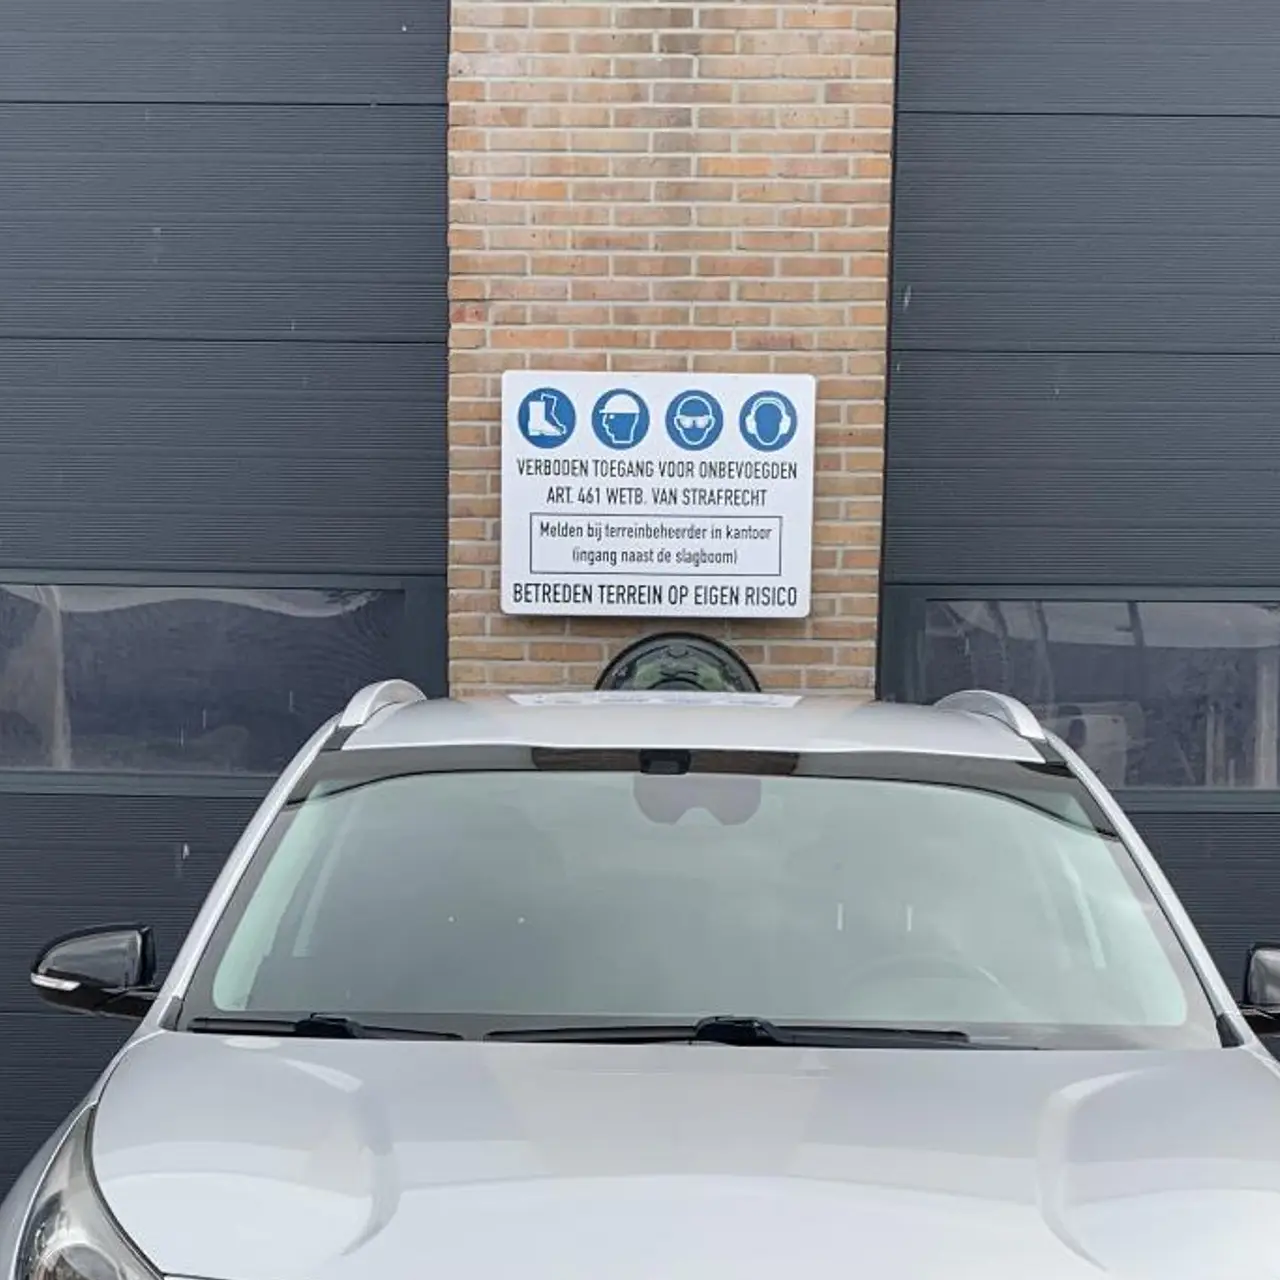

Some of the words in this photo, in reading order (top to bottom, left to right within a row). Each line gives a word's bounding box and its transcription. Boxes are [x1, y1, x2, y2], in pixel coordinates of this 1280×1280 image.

[516, 459, 588, 477] VERBODEN
[593, 460, 654, 478] TOEGANG
[659, 461, 694, 478] VOOR
[699, 461, 797, 480] ONBEVOEGDEN
[546, 486, 573, 504] ART.
[577, 487, 600, 504] 461
[606, 487, 647, 505] WETB.
[652, 488, 677, 505] VAN
[682, 488, 767, 507] STRAFRECHT
[540, 521, 583, 538] Melden
[587, 522, 602, 542] bij
[605, 523, 707, 540] terreinbeheerder
[711, 525, 722, 540] in
[726, 525, 772, 540] kantoor
[572, 546, 617, 566] (ingang
[621, 549, 654, 563] naast
[657, 549, 671, 563] de
[675, 549, 738, 567] slagboom)
[513, 583, 593, 604] BETREDEN
[597, 584, 663, 605] TERREIN
[668, 585, 688, 605] OP
[694, 585, 739, 607] EIGEN
[745, 586, 797, 607] RISICO
